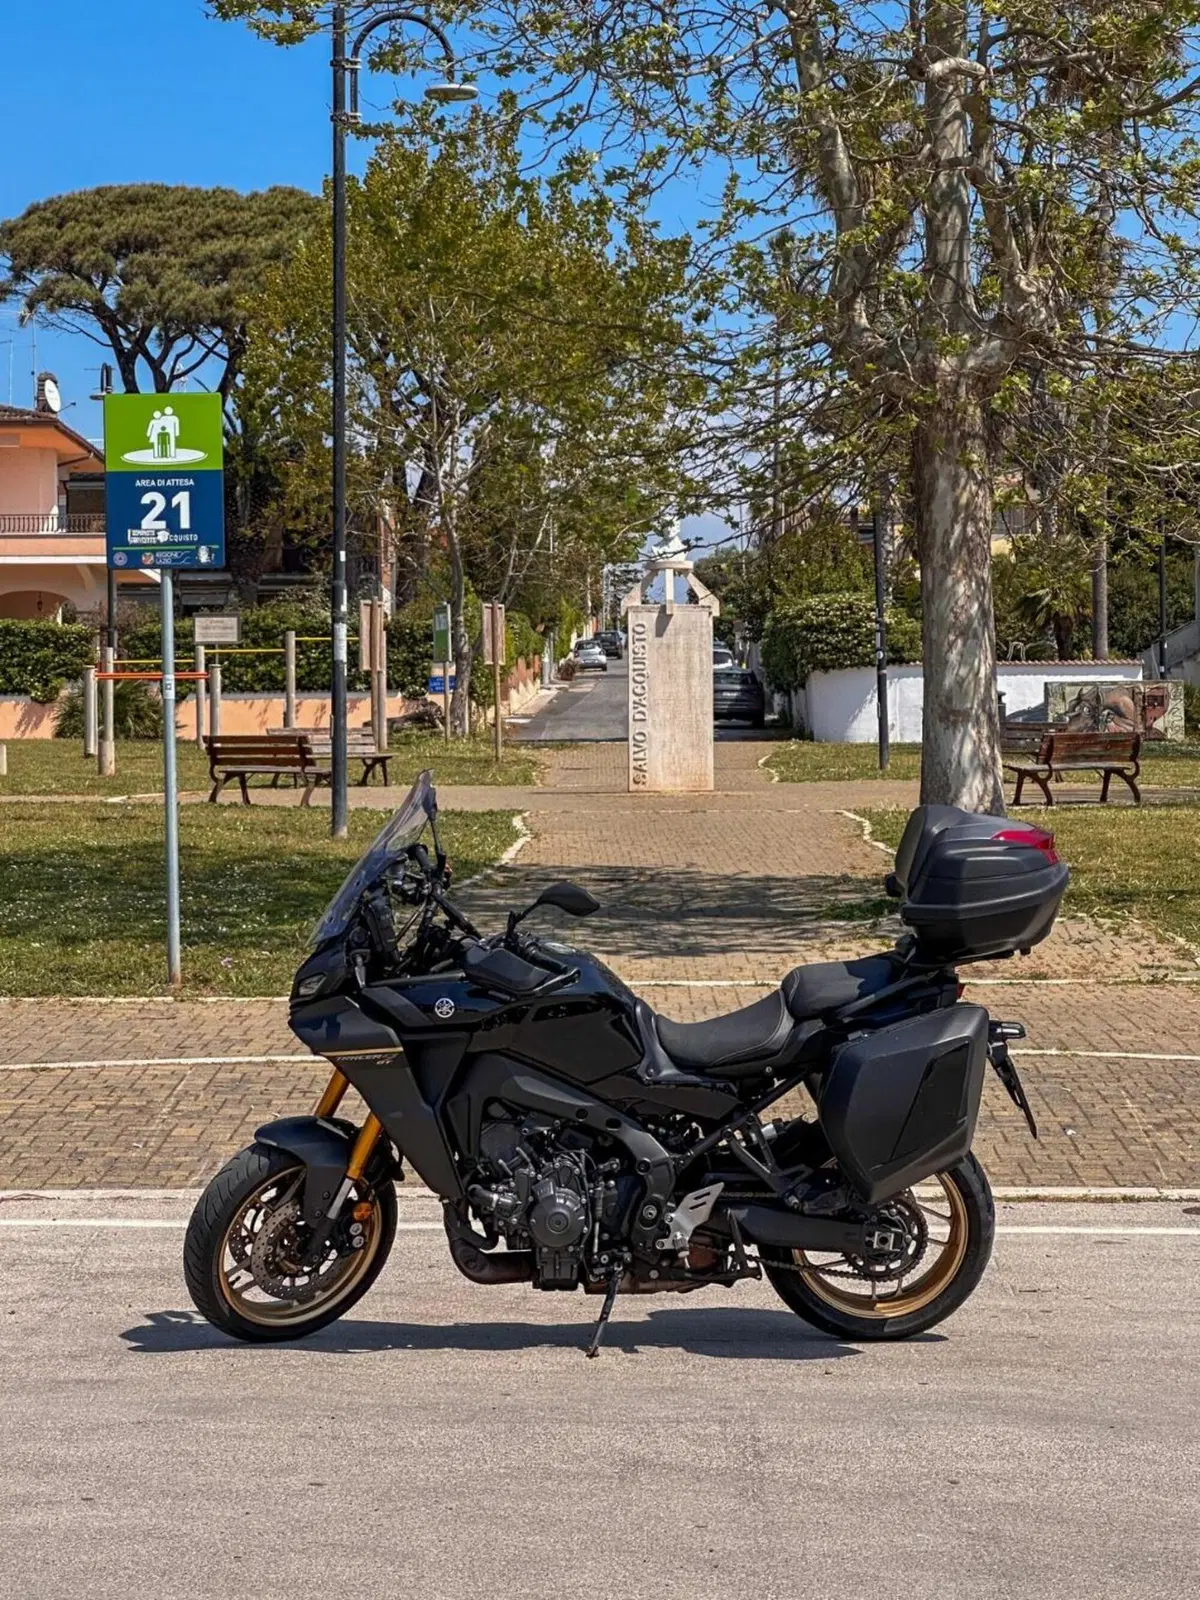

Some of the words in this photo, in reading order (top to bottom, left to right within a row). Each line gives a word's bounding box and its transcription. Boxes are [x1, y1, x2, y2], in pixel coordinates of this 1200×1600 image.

[135, 479, 156, 487] AREA
[166, 478, 195, 486] ATTESA
[140, 491, 191, 530] 21
[632, 622, 650, 723] D'ACQUISTO
[632, 731, 647, 786] SALVO
